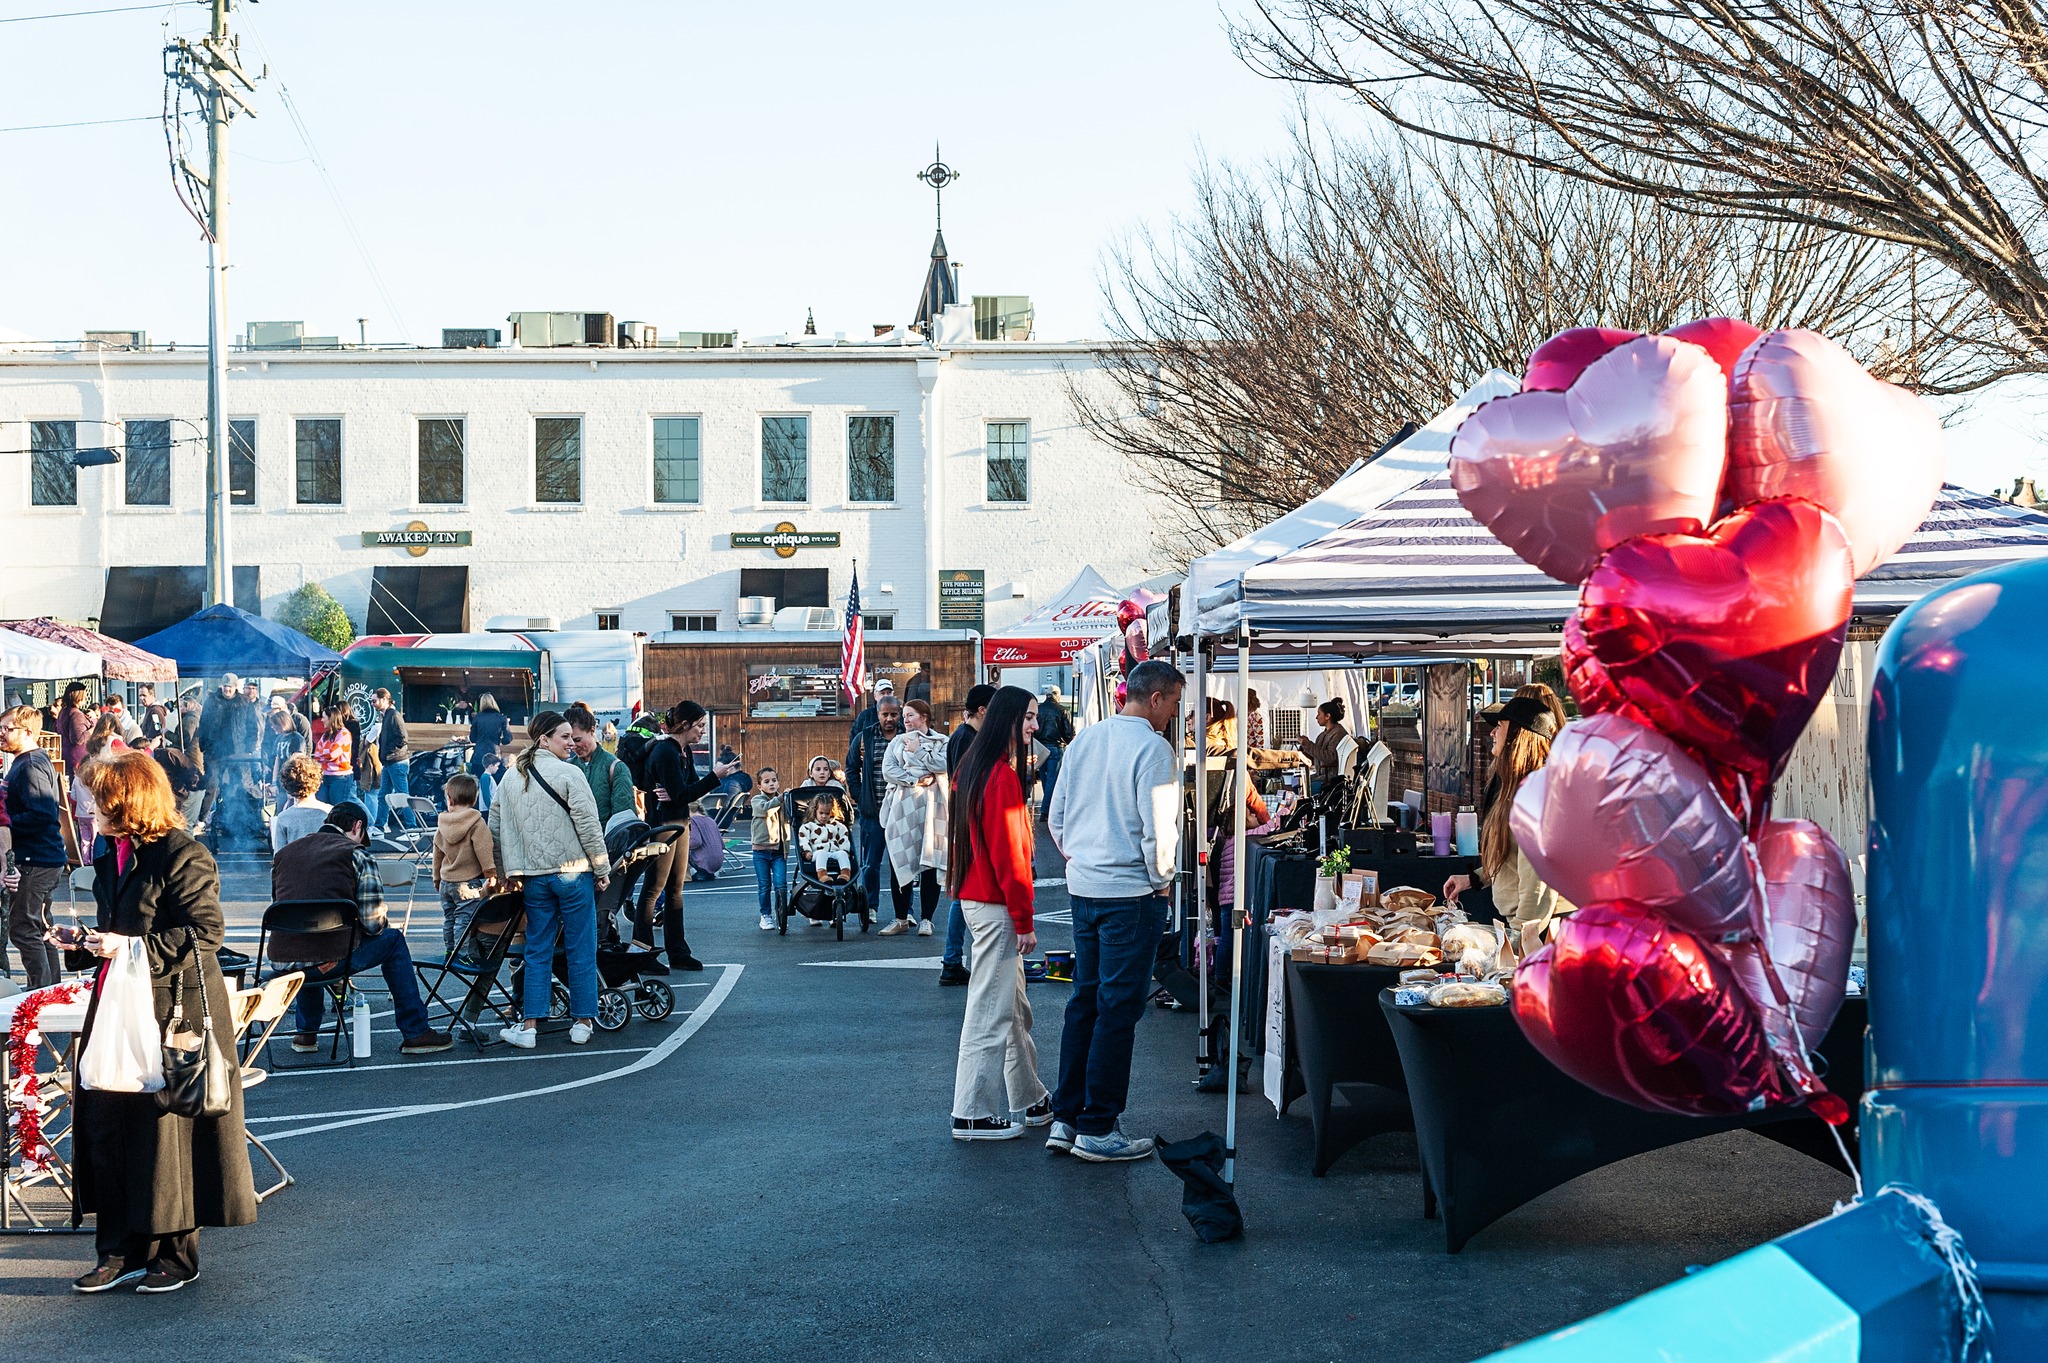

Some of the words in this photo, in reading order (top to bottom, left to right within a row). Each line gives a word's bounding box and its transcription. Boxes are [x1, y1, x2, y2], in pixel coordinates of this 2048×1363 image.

[377, 533, 433, 543] AWAKEN
[437, 533, 457, 543] TN
[763, 533, 810, 547] optique
[1052, 601, 1117, 621] Ellie
[1060, 639, 1079, 647] OLD
[1827, 668, 1854, 697] ONZE
